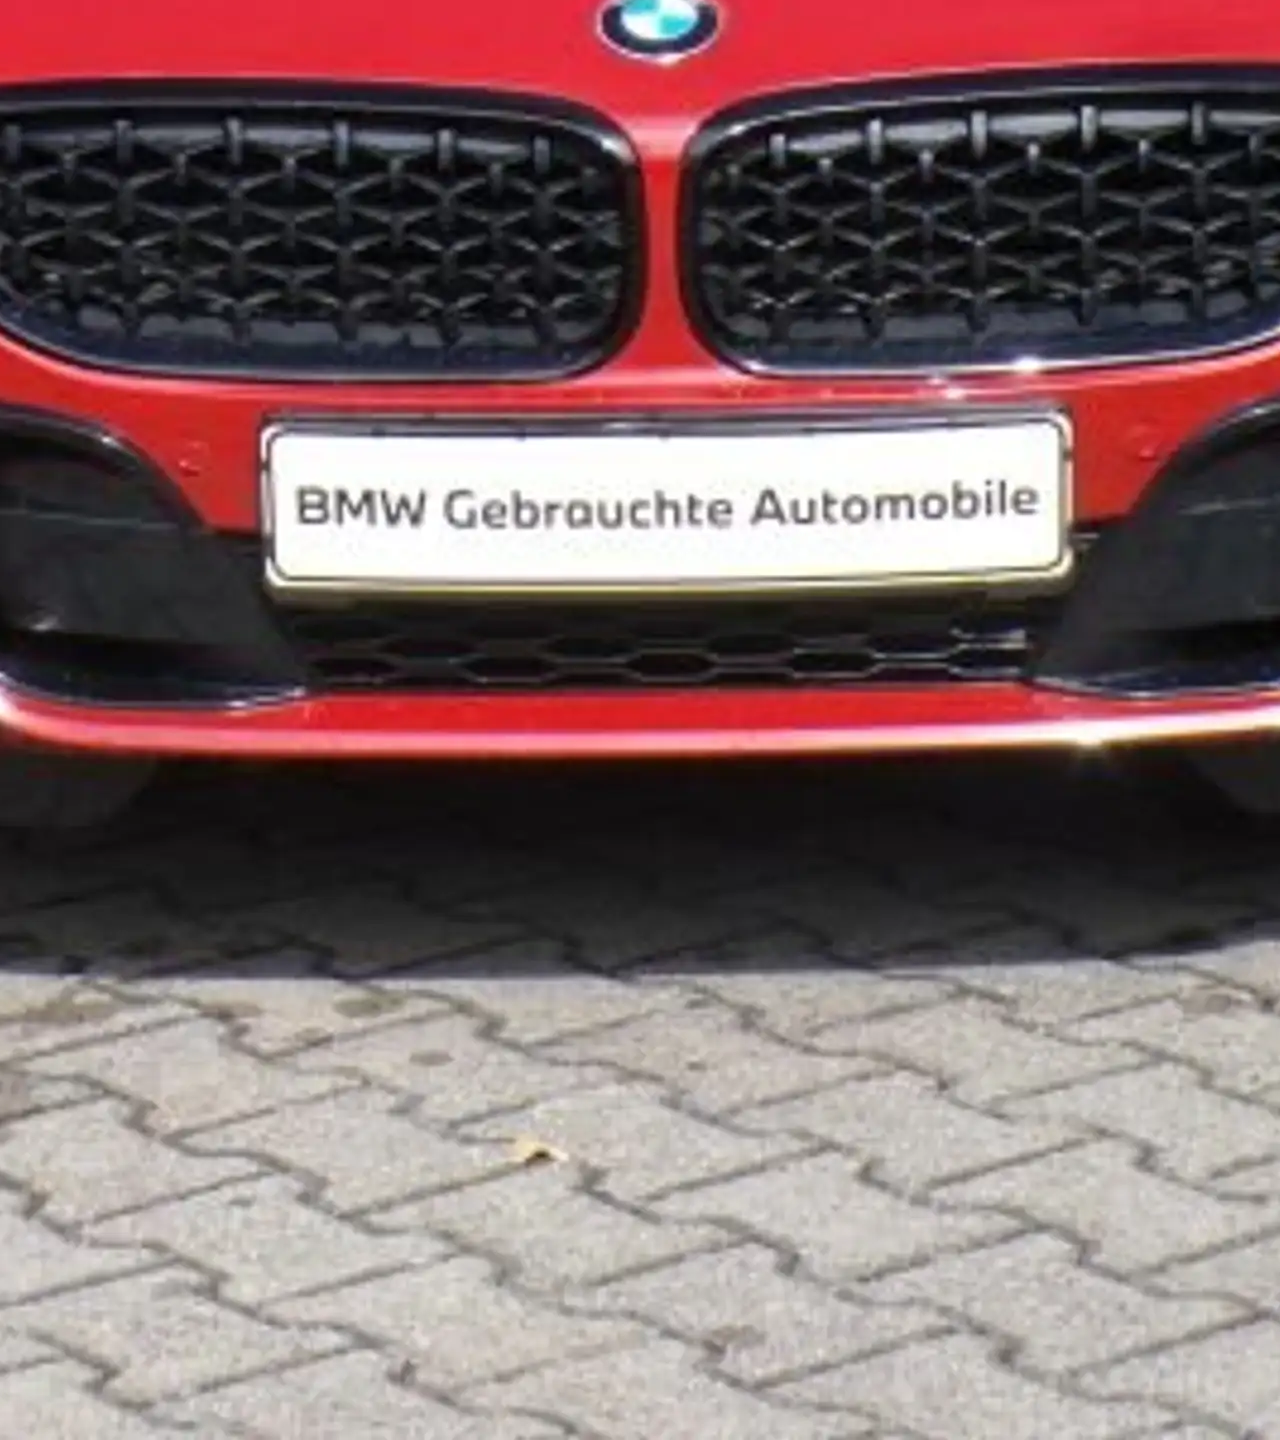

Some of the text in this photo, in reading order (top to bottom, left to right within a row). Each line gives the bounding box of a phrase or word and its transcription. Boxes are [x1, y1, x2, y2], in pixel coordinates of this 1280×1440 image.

[295, 479, 1041, 530] BMW Gebrauchte Automobile
